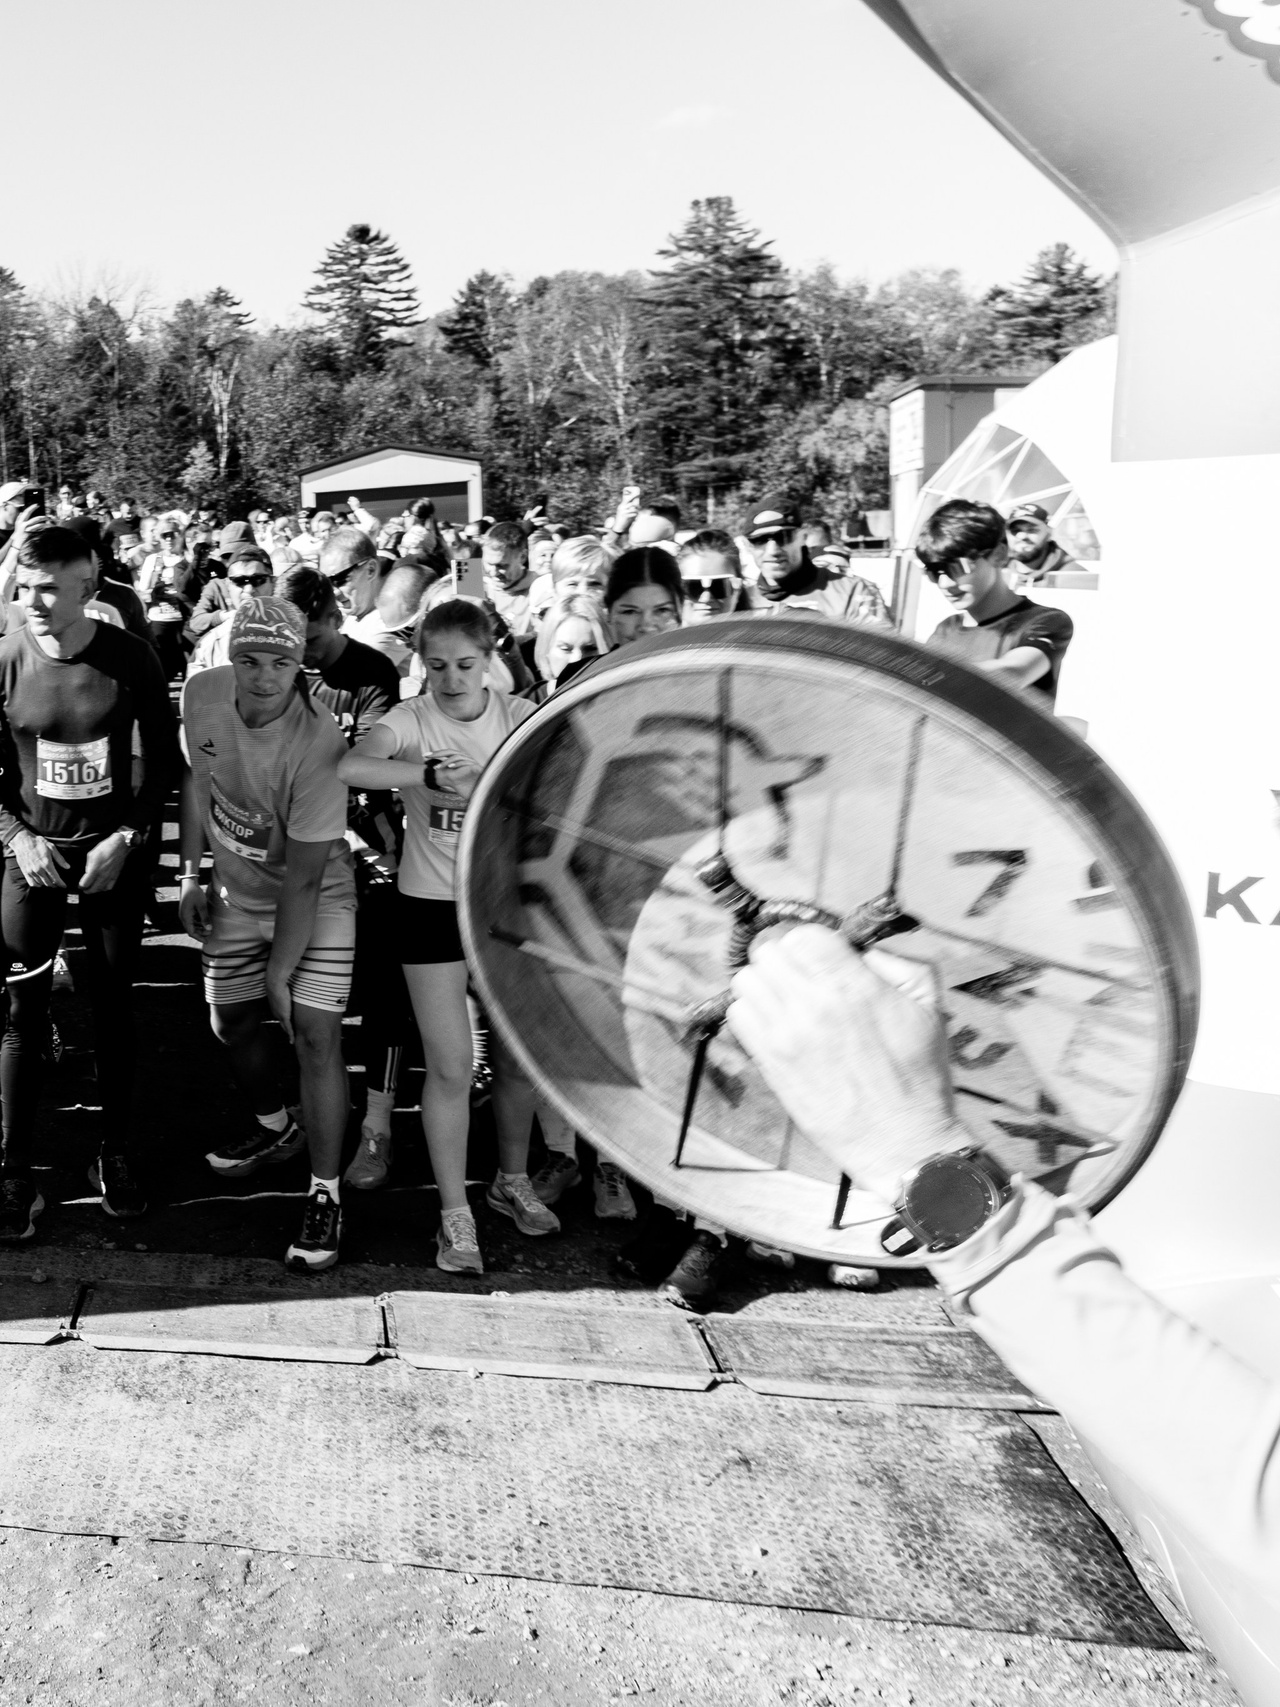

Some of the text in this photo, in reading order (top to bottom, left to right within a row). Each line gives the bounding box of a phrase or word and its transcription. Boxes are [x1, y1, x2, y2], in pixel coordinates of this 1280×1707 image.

[42, 758, 107, 783] 15167
[214, 804, 254, 838] ВИКТОР
[1204, 871, 1280, 926] K
